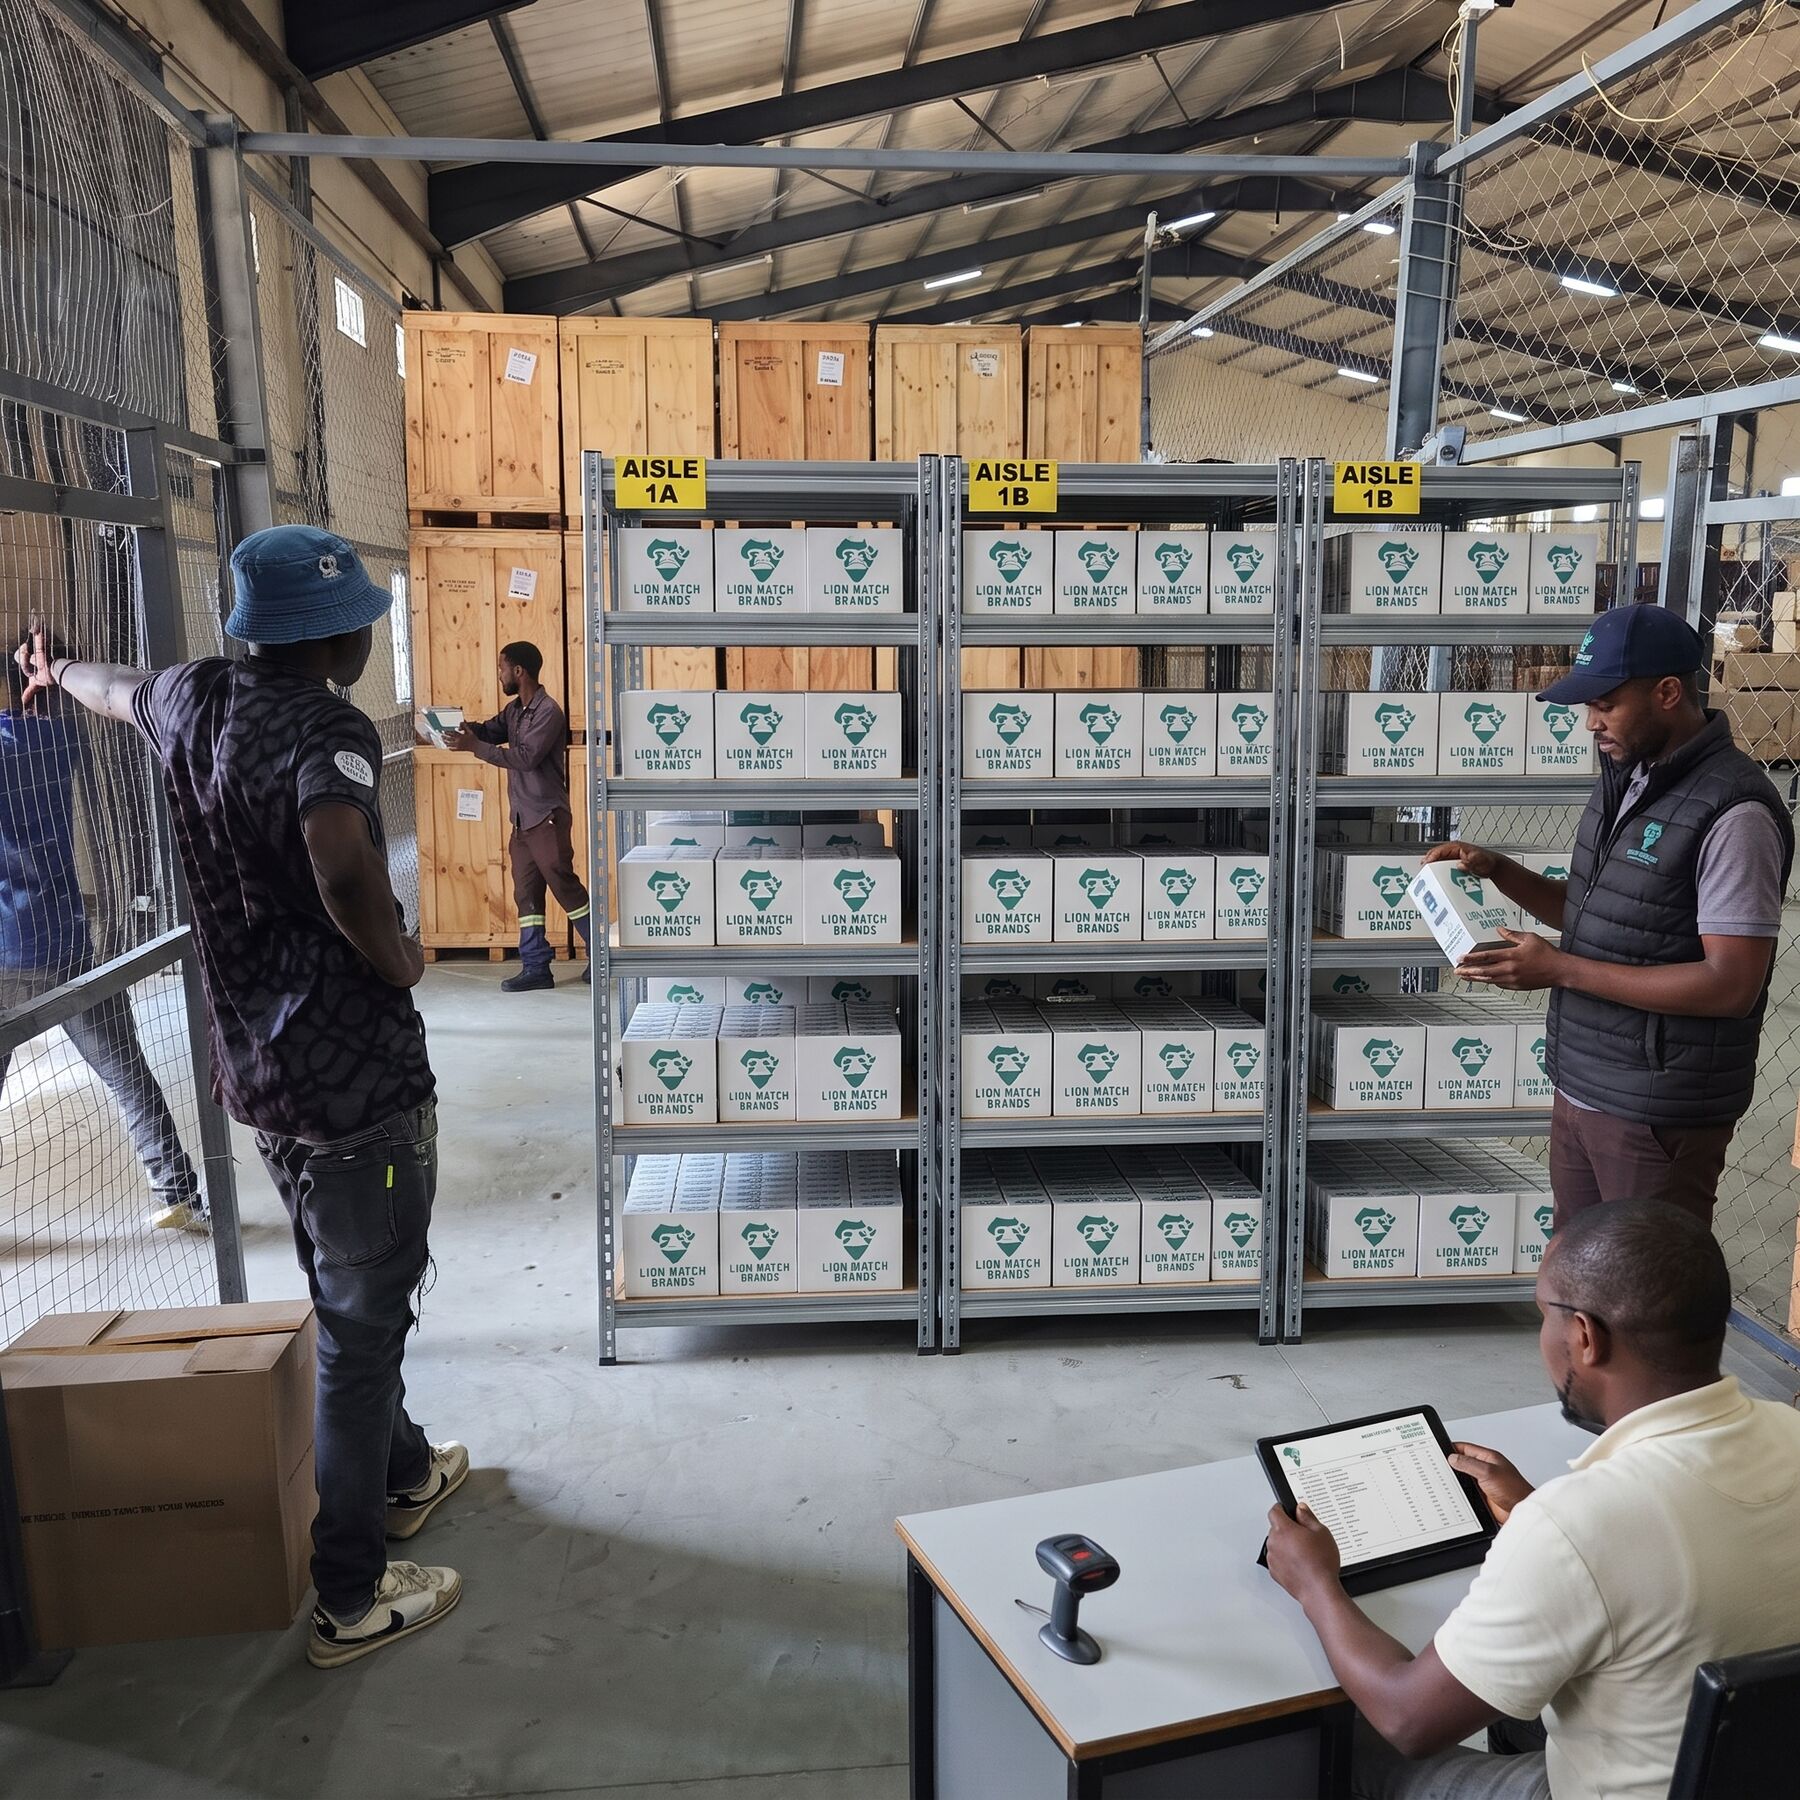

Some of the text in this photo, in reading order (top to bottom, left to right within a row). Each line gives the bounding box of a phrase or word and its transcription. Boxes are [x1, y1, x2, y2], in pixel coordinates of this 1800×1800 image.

[622, 459, 699, 479] AISLE
[975, 463, 1050, 482] AISLE
[1341, 465, 1414, 485] AISLE
[645, 483, 679, 503] 1A
[998, 486, 1029, 506] 1B
[1363, 489, 1393, 508] 1B
[634, 584, 700, 596] LION MATCH
[727, 584, 794, 595] LION MATCH
[824, 584, 889, 595] LION MATCH
[976, 585, 1042, 596] LION MATCH
[1063, 585, 1128, 596] LION MATCH
[1142, 585, 1202, 595] LION MATCH
[1215, 585, 1273, 594] LION MATCH
[1365, 585, 1428, 596] LION MATCH
[1454, 586, 1517, 596] LION MATCH
[1535, 585, 1589, 595] LION MATCH
[646, 595, 691, 605] BRANDS
[738, 595, 782, 606] BRANDS
[835, 595, 879, 606] BRANDS
[987, 596, 1032, 607] BRANDS
[1074, 596, 1117, 607] BRANDS
[1153, 595, 1192, 605] BRANDS
[1376, 597, 1417, 607] BRANDS
[1465, 596, 1507, 607] BRANDS
[1544, 595, 1580, 605] BRANDS
[635, 748, 702, 760] LION MATCH
[726, 748, 793, 759] LION MATCH
[822, 748, 887, 759] LION MATCH
[975, 748, 1041, 759] LION MATCH
[1065, 748, 1131, 759] LION MATCH
[1149, 747, 1171, 757] LION
[1220, 745, 1242, 756] LION
[1362, 747, 1424, 757] LION MATCH
[1450, 746, 1513, 757] LION MATCH
[1556, 745, 1587, 755] MATCH
[647, 759, 691, 770] BRANDS
[738, 759, 782, 770] BRANDS
[833, 759, 877, 770] BRANDS
[988, 759, 1031, 770] BRANDS
[1076, 759, 1121, 770] BRANDS
[1159, 756, 1198, 766] BRANDS
[1230, 755, 1268, 765] BRANDS
[1373, 758, 1415, 768] BRANDS
[1462, 757, 1503, 767] BRANDS
[1541, 755, 1578, 764] BRANDS
[975, 913, 1041, 924] LION MATCH
[1064, 912, 1130, 923] LION MATCH
[1173, 910, 1206, 920] MATCH
[1217, 908, 1240, 918] LION
[1358, 910, 1383, 921] LION
[634, 915, 701, 926] LION MATCH
[726, 914, 793, 925] LION MATCH
[821, 914, 887, 924] LION MATCH
[1157, 919, 1197, 929] BRANDS
[739, 925, 782, 936] BRANDS
[833, 925, 877, 936] BRANDS
[987, 924, 1030, 934] BRANDS
[1077, 923, 1119, 933] BRANDS
[1370, 920, 1412, 931] BRANDS
[1214, 1080, 1236, 1091] LION
[1349, 1080, 1413, 1092] LION MATCH
[1438, 1079, 1501, 1090] LION MATCH
[1516, 1077, 1538, 1087] LION
[975, 1087, 1041, 1098] LION MATCH
[1064, 1086, 1129, 1097] LION MATCH
[1147, 1083, 1169, 1093] LION
[1526, 1086, 1555, 1096] BRAN
[638, 1093, 704, 1104] LION MATCH
[756, 1091, 789, 1102] MATCH
[822, 1089, 888, 1101] LION MATCH
[1360, 1091, 1403, 1101] BRANDS
[1449, 1090, 1491, 1100] BRANDS
[833, 1099, 877, 1111] BRANDS
[987, 1098, 1030, 1109] BRANDS
[1076, 1096, 1119, 1107] BRANDS
[650, 1104, 694, 1115] BRANDS
[1342, 1248, 1405, 1260] LION MATCH
[1436, 1246, 1498, 1257] LION MATCH
[1520, 1244, 1542, 1254] LION
[1064, 1258, 1089, 1268] LION
[1145, 1253, 1168, 1263] LION
[1353, 1258, 1394, 1269] BRANDS
[1445, 1256, 1489, 1267] BRANDS
[729, 1264, 753, 1273] LION
[822, 1261, 888, 1273] LION MATCH
[975, 1258, 1040, 1270] LION MATCH
[1156, 1261, 1195, 1272] BRANDS
[640, 1266, 706, 1278] LION MATCH
[740, 1271, 779, 1282] BRANDS
[834, 1271, 877, 1282] BRANDS
[986, 1268, 1030, 1280] BRANDS
[1075, 1266, 1118, 1278] BRANDS
[652, 1276, 695, 1287] BRANDS
